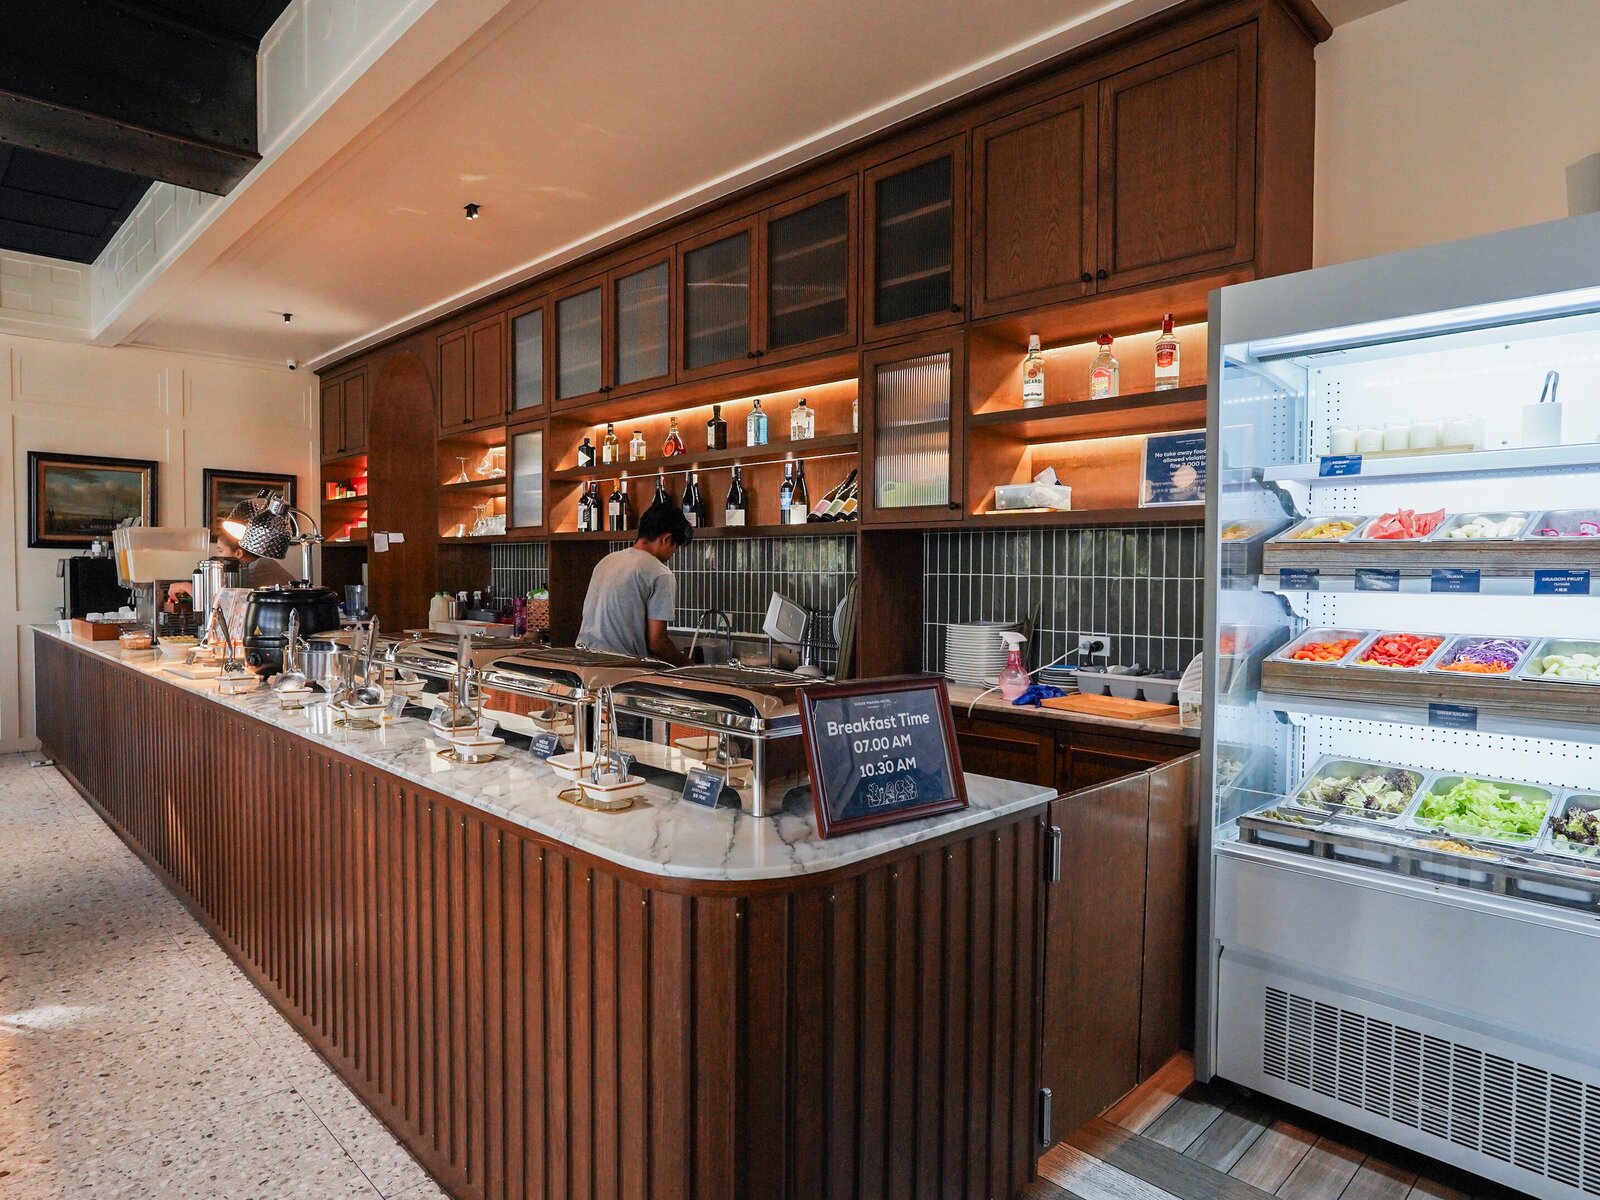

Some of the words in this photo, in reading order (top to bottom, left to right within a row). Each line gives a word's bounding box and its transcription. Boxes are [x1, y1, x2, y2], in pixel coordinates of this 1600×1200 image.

[827, 715, 896, 737] Breakfast
[898, 712, 930, 727] Time
[853, 736, 889, 754] 07.00
[892, 734, 912, 748] AM
[859, 760, 894, 778] 10.30
[897, 757, 917, 771] AM
